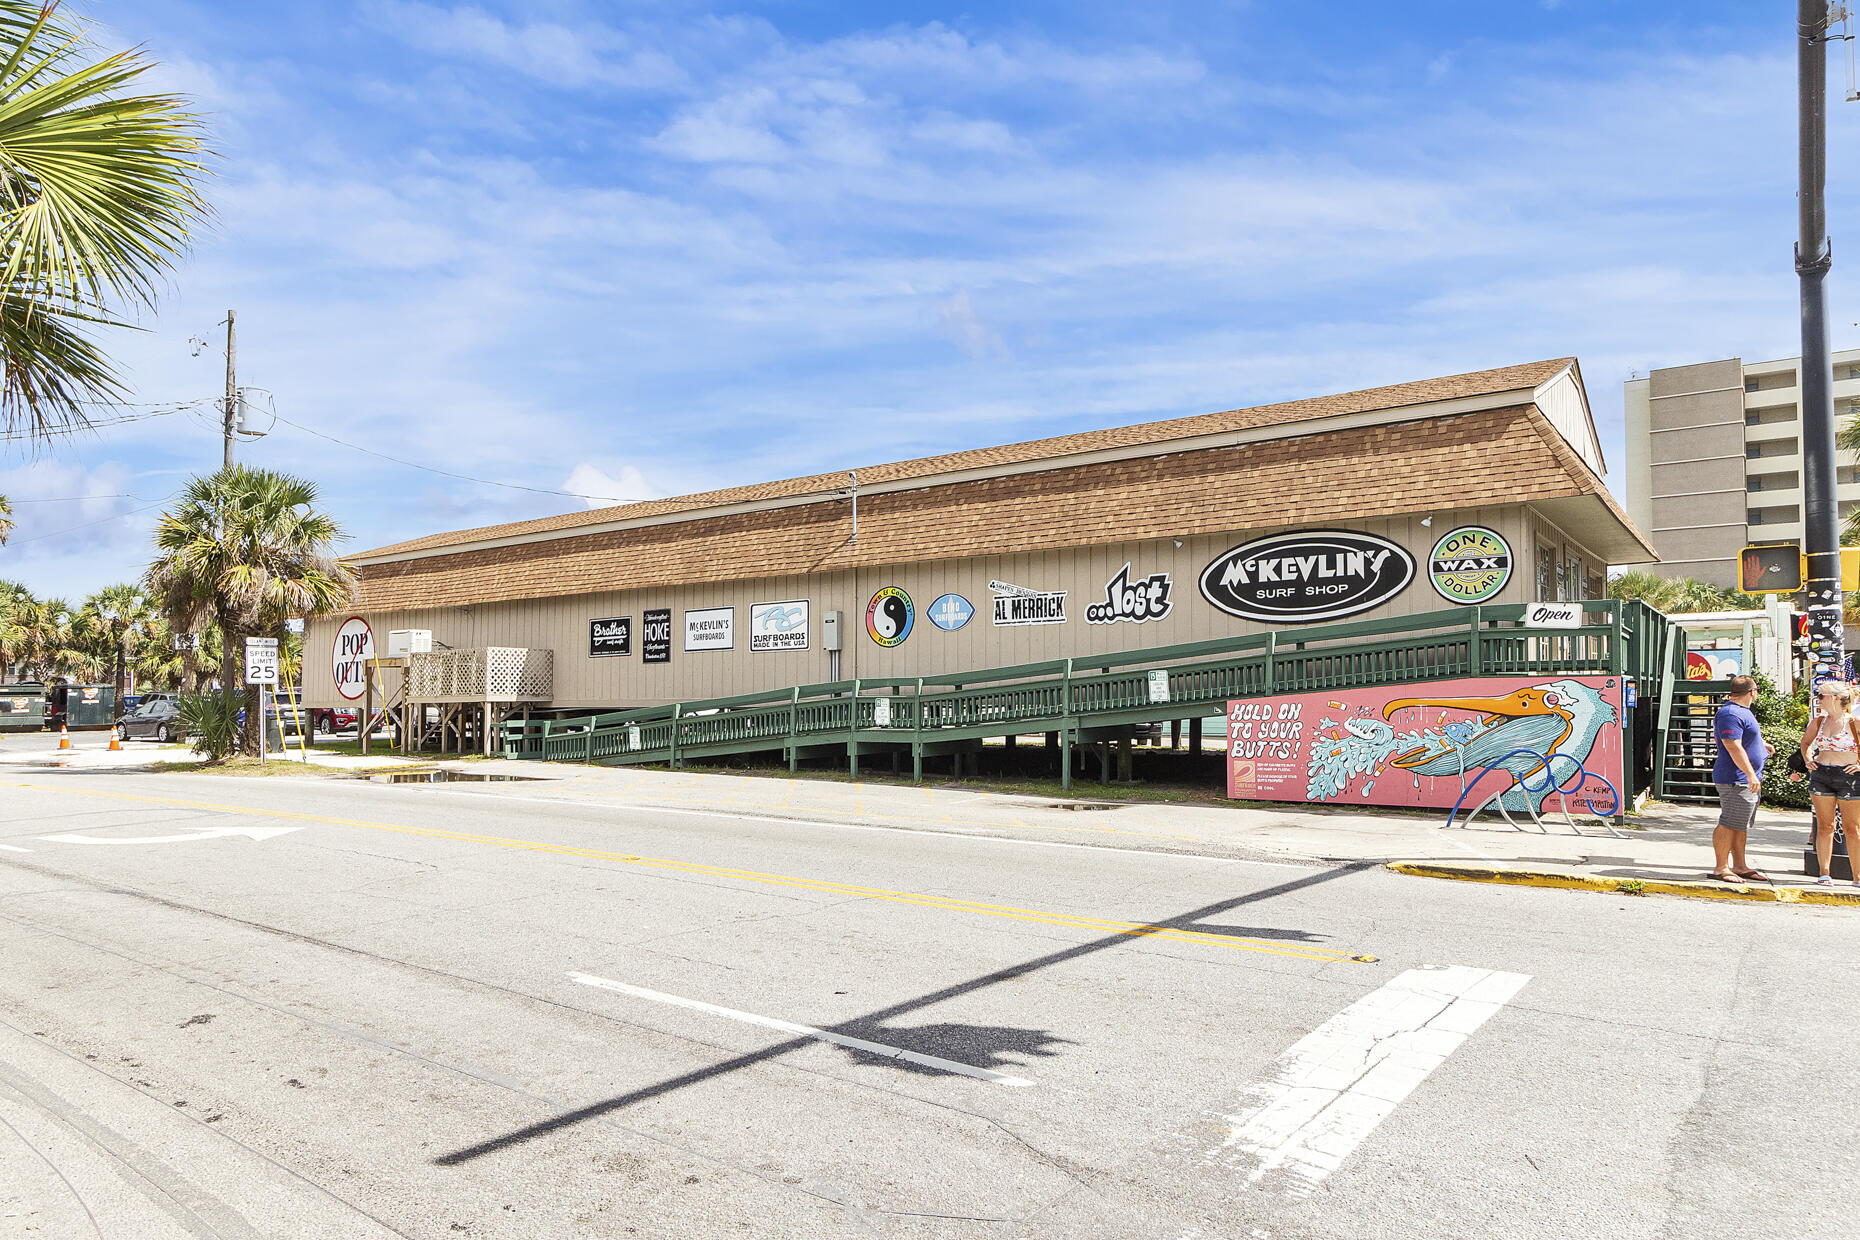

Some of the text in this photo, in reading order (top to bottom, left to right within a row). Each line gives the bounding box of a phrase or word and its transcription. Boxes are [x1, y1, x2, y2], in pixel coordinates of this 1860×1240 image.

[1446, 533, 1492, 552] ONE
[1438, 557, 1499, 571] WAX
[1256, 584, 1349, 599] SURF SHOP
[1444, 574, 1498, 595] DOLLAR
[868, 595, 882, 614] Town
[995, 596, 1064, 620] AL MERRICK
[1532, 607, 1574, 623] Open
[593, 621, 627, 637] Brother
[644, 622, 669, 641] HOKE
[693, 632, 725, 641] SURFBOARDS
[753, 632, 806, 643] SURFBOARDS
[341, 633, 368, 656] POP
[772, 640, 779, 648] IN
[878, 636, 902, 645] Hawaii
[251, 666, 275, 678] 25
[1230, 703, 1303, 721] HOLD ON
[1230, 720, 1303, 740] TO YOUR
[1230, 739, 1302, 760] BUTTS!
